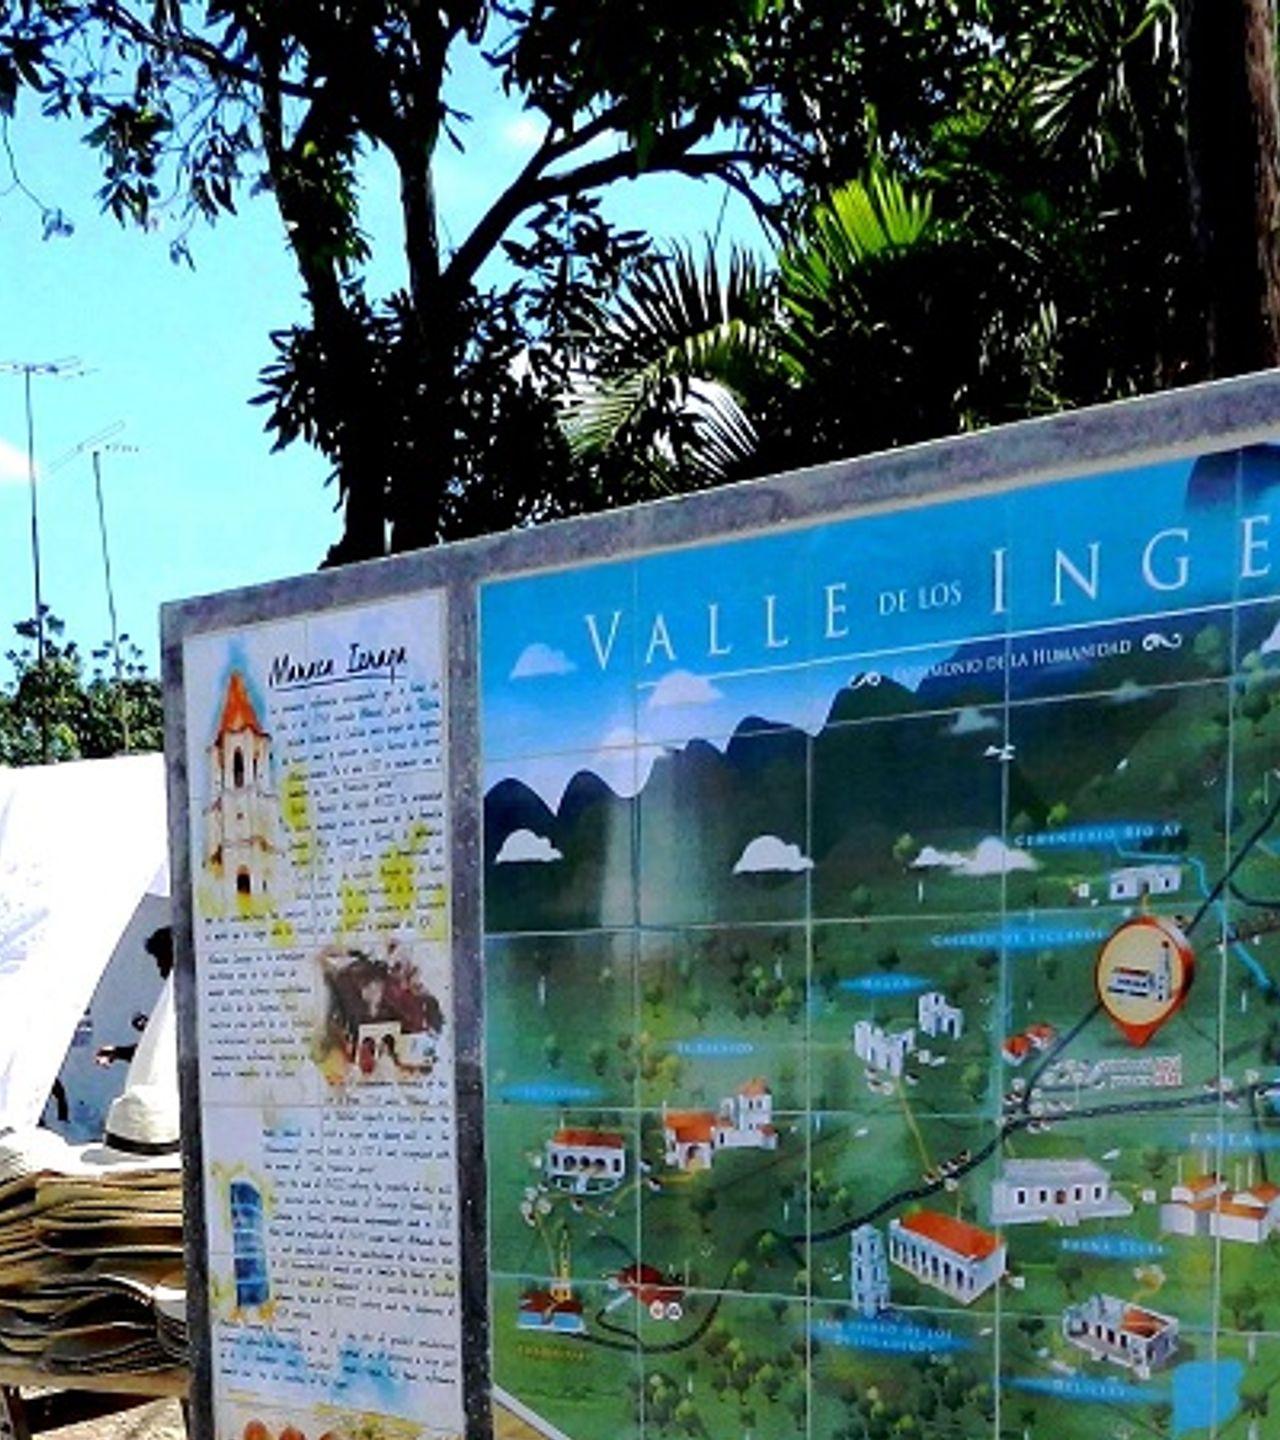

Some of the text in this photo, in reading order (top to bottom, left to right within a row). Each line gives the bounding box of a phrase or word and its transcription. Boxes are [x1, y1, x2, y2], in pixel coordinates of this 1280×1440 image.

[584, 583, 850, 671] VALLE
[878, 592, 908, 616] DE
[918, 580, 962, 607] LOS
[1033, 639, 1132, 665] HUMANIDAD
[269, 653, 334, 688] Manaca
